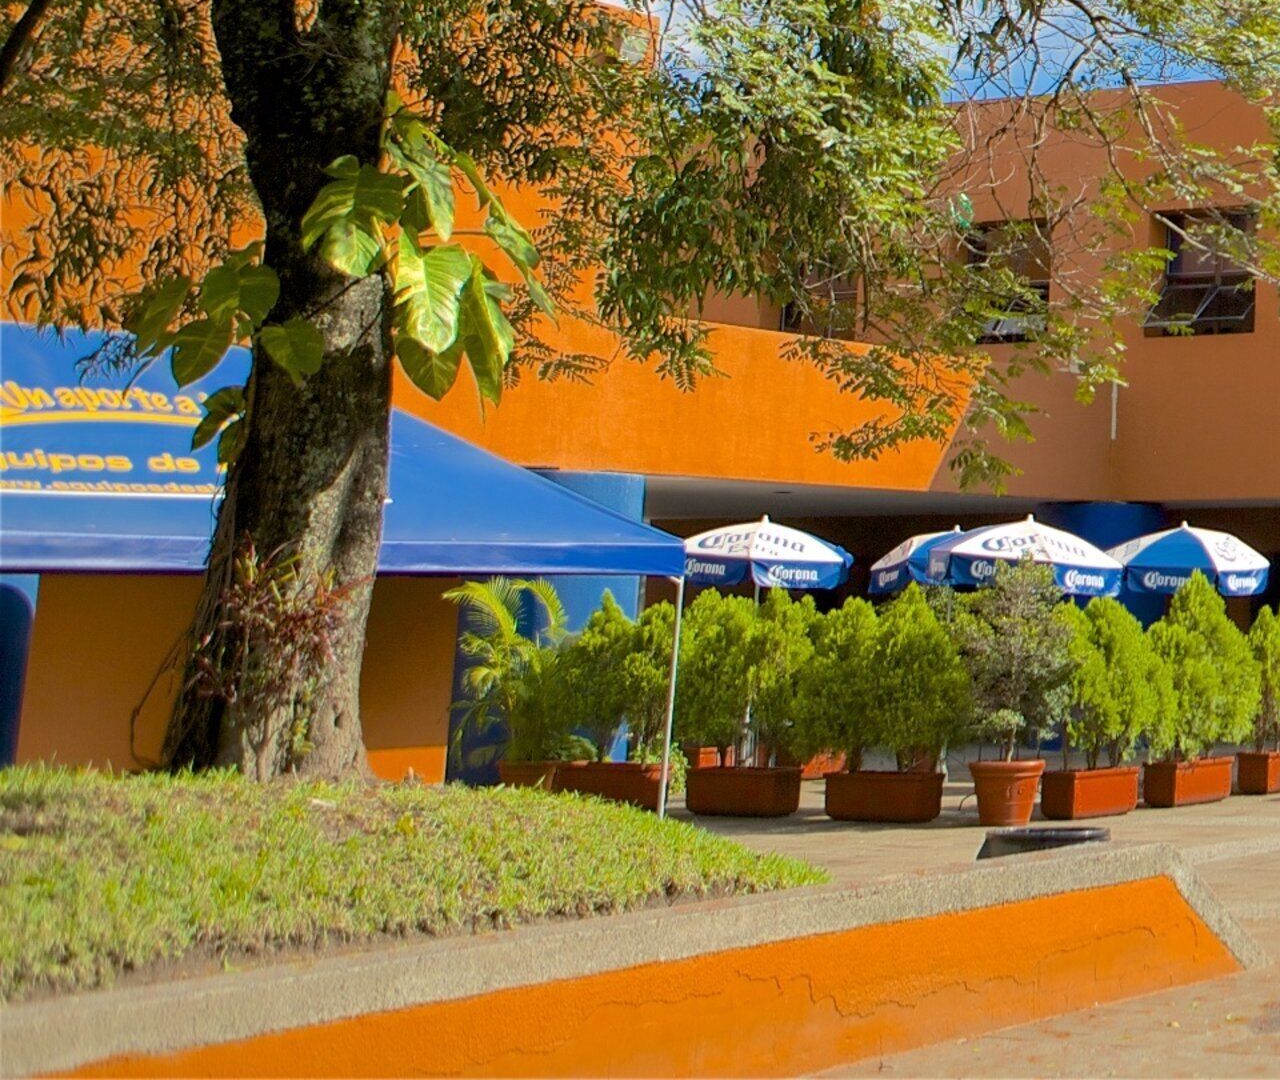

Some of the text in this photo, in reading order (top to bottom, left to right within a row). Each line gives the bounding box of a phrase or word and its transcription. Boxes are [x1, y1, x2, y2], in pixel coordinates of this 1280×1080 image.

[54, 387, 174, 412] aporte
[147, 452, 201, 473] de
[698, 531, 806, 553] Corona
[685, 557, 727, 576] Corona
[768, 563, 819, 582] Corona
[1065, 569, 1105, 589] Corona
